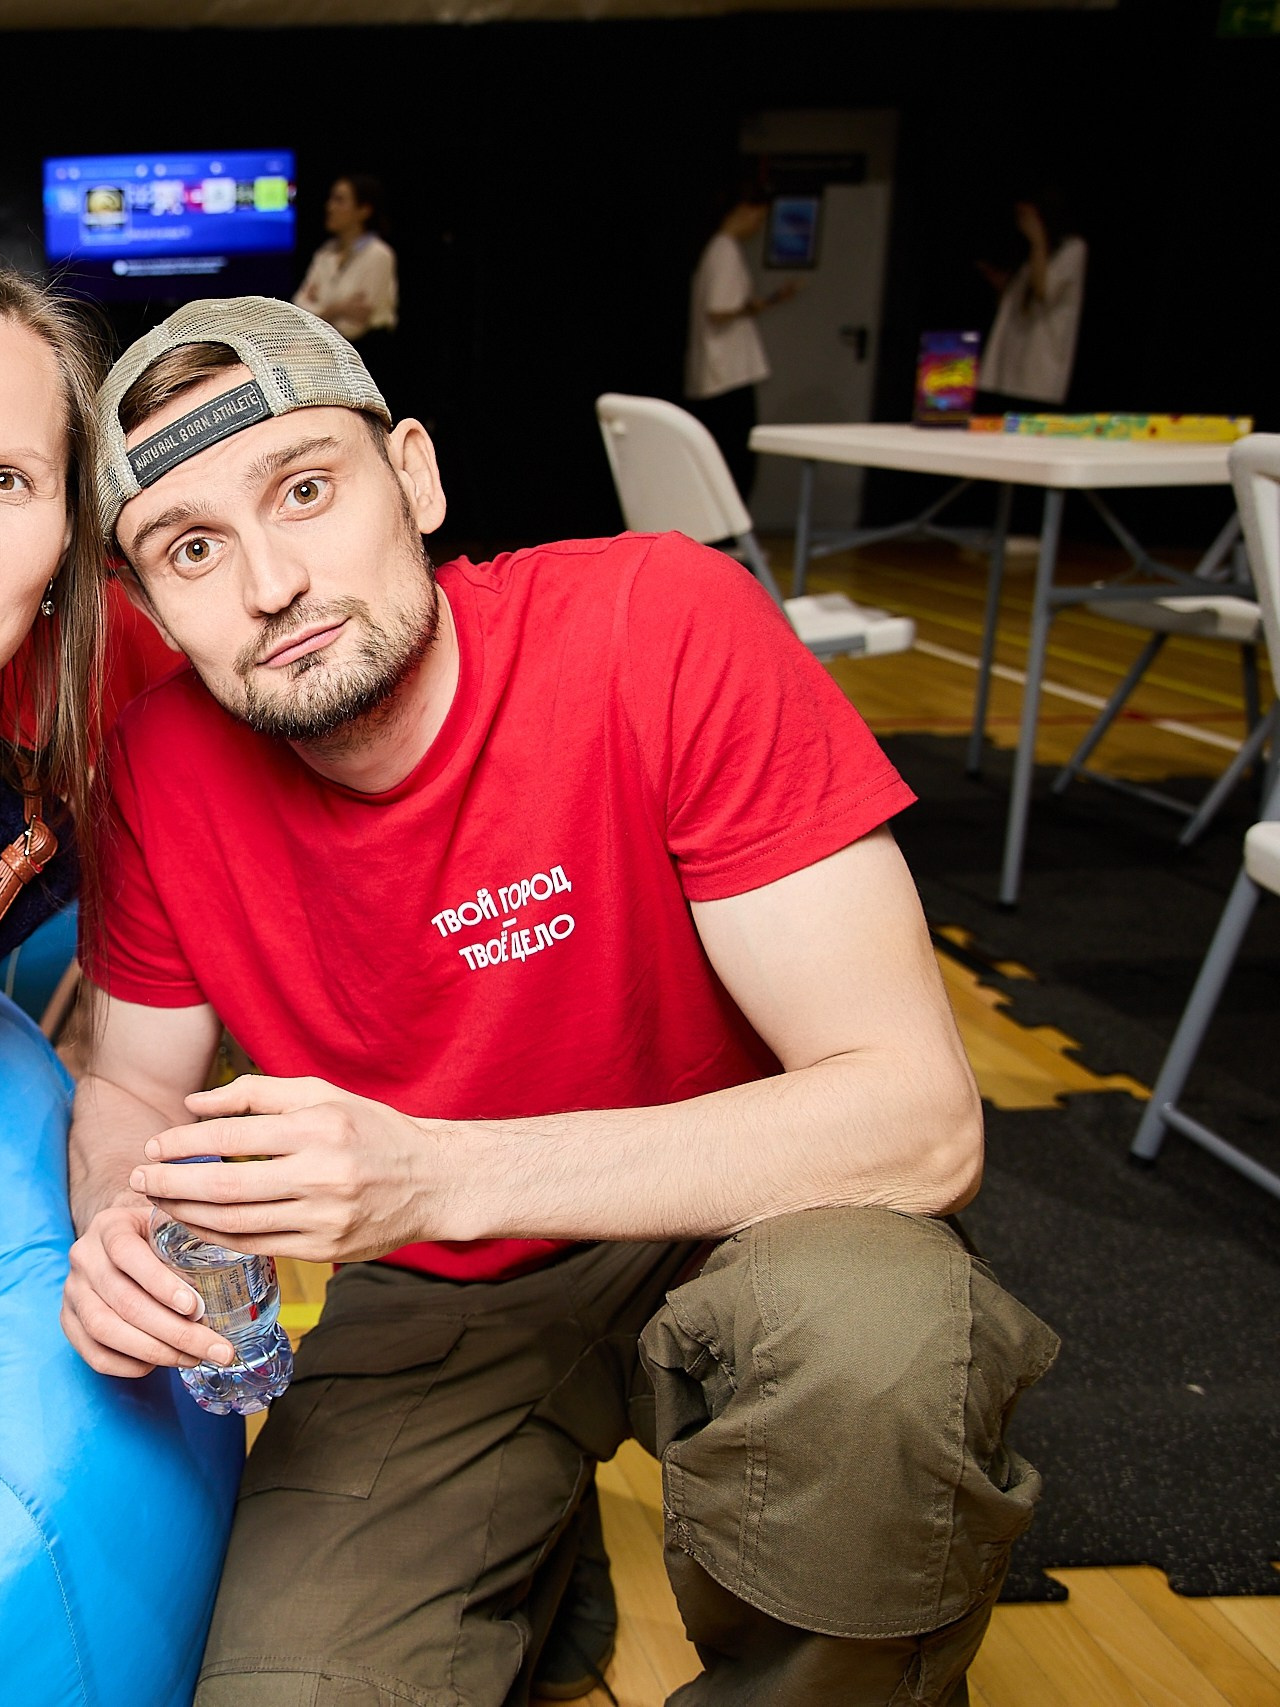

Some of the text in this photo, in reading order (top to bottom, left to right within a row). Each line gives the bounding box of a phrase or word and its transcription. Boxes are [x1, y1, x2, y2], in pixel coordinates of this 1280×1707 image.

[133, 391, 259, 472] NATURAL BORN ATHLETE
[431, 865, 572, 938] ТВОЙ ГОРОД
[458, 913, 575, 971] ТВОЁ ДЕЛО
